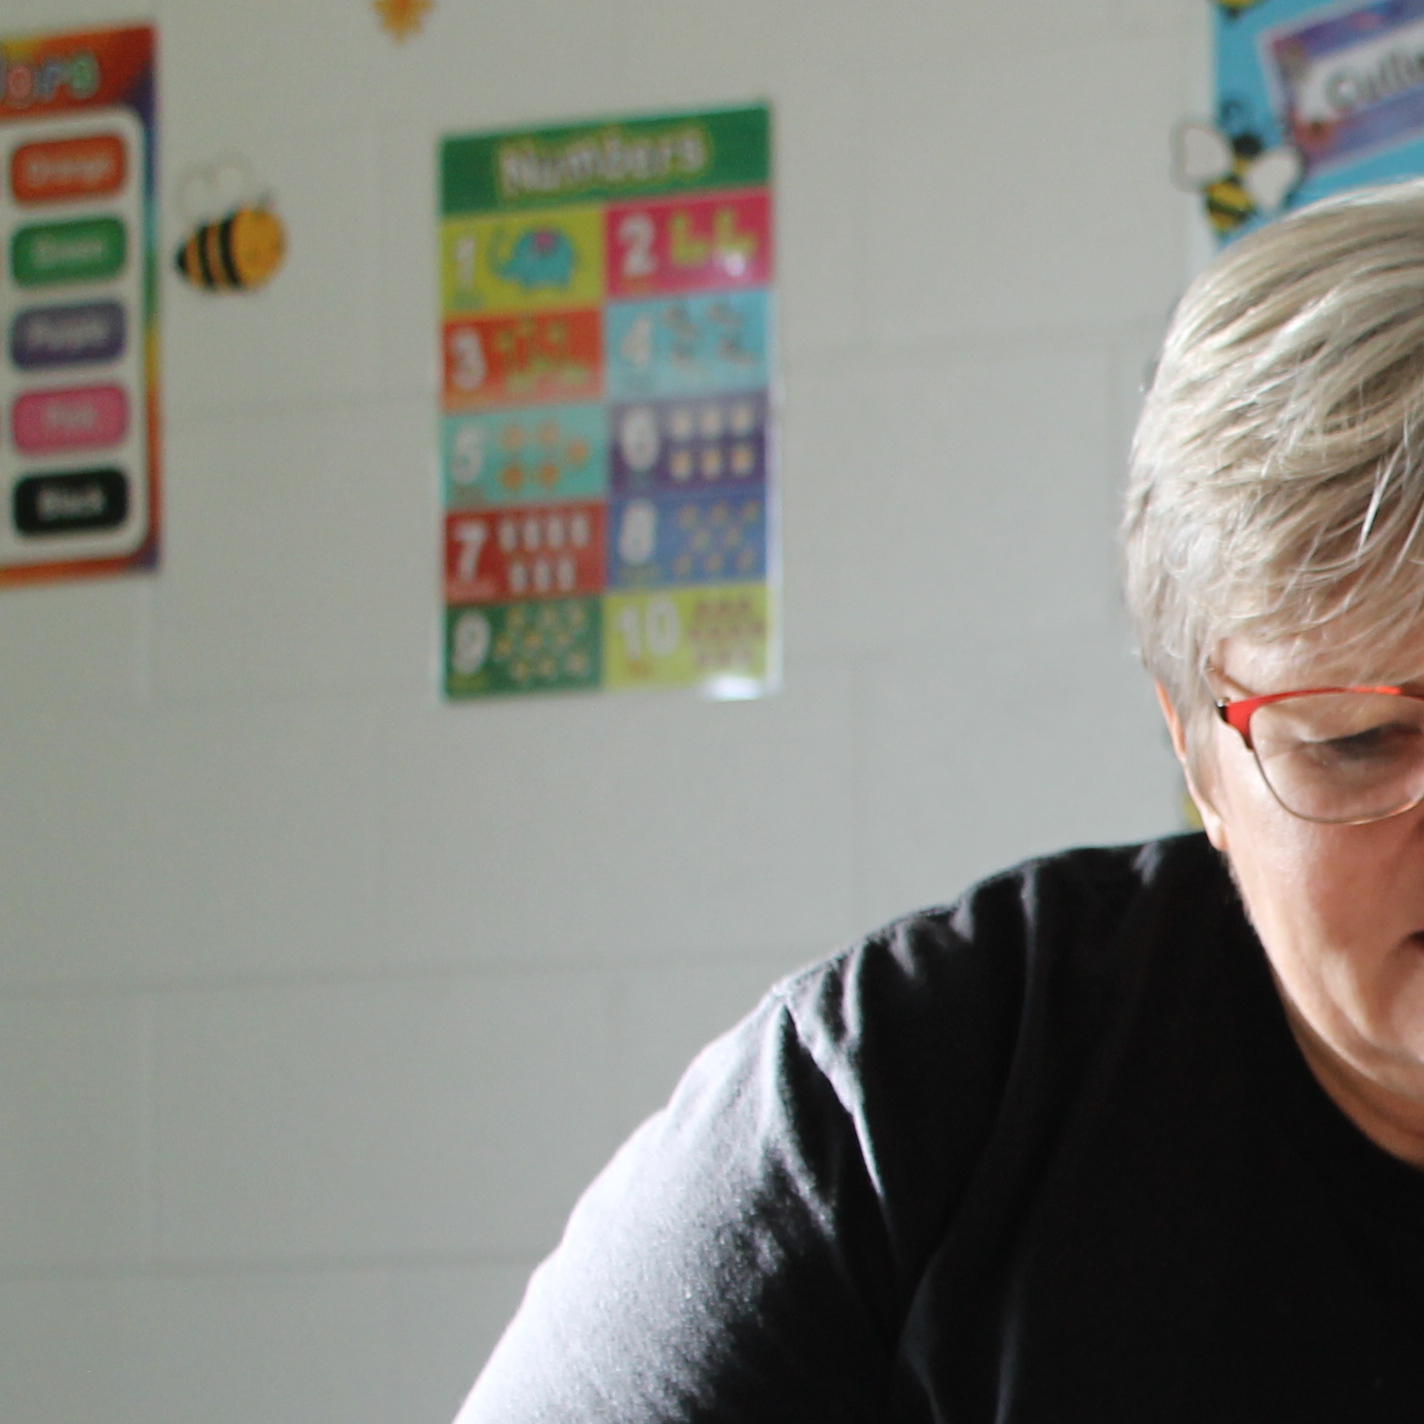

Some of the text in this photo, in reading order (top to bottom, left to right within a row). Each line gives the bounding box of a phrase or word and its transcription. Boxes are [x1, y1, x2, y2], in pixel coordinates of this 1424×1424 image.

[501, 125, 706, 197] Numbers
[617, 212, 658, 279] 2
[452, 326, 487, 390] 3
[620, 310, 653, 368] 4
[452, 423, 484, 485] 5
[621, 402, 660, 473] 6
[453, 513, 489, 584] 7
[619, 500, 659, 566] 8
[453, 610, 491, 676] 9
[617, 590, 681, 663] 10
